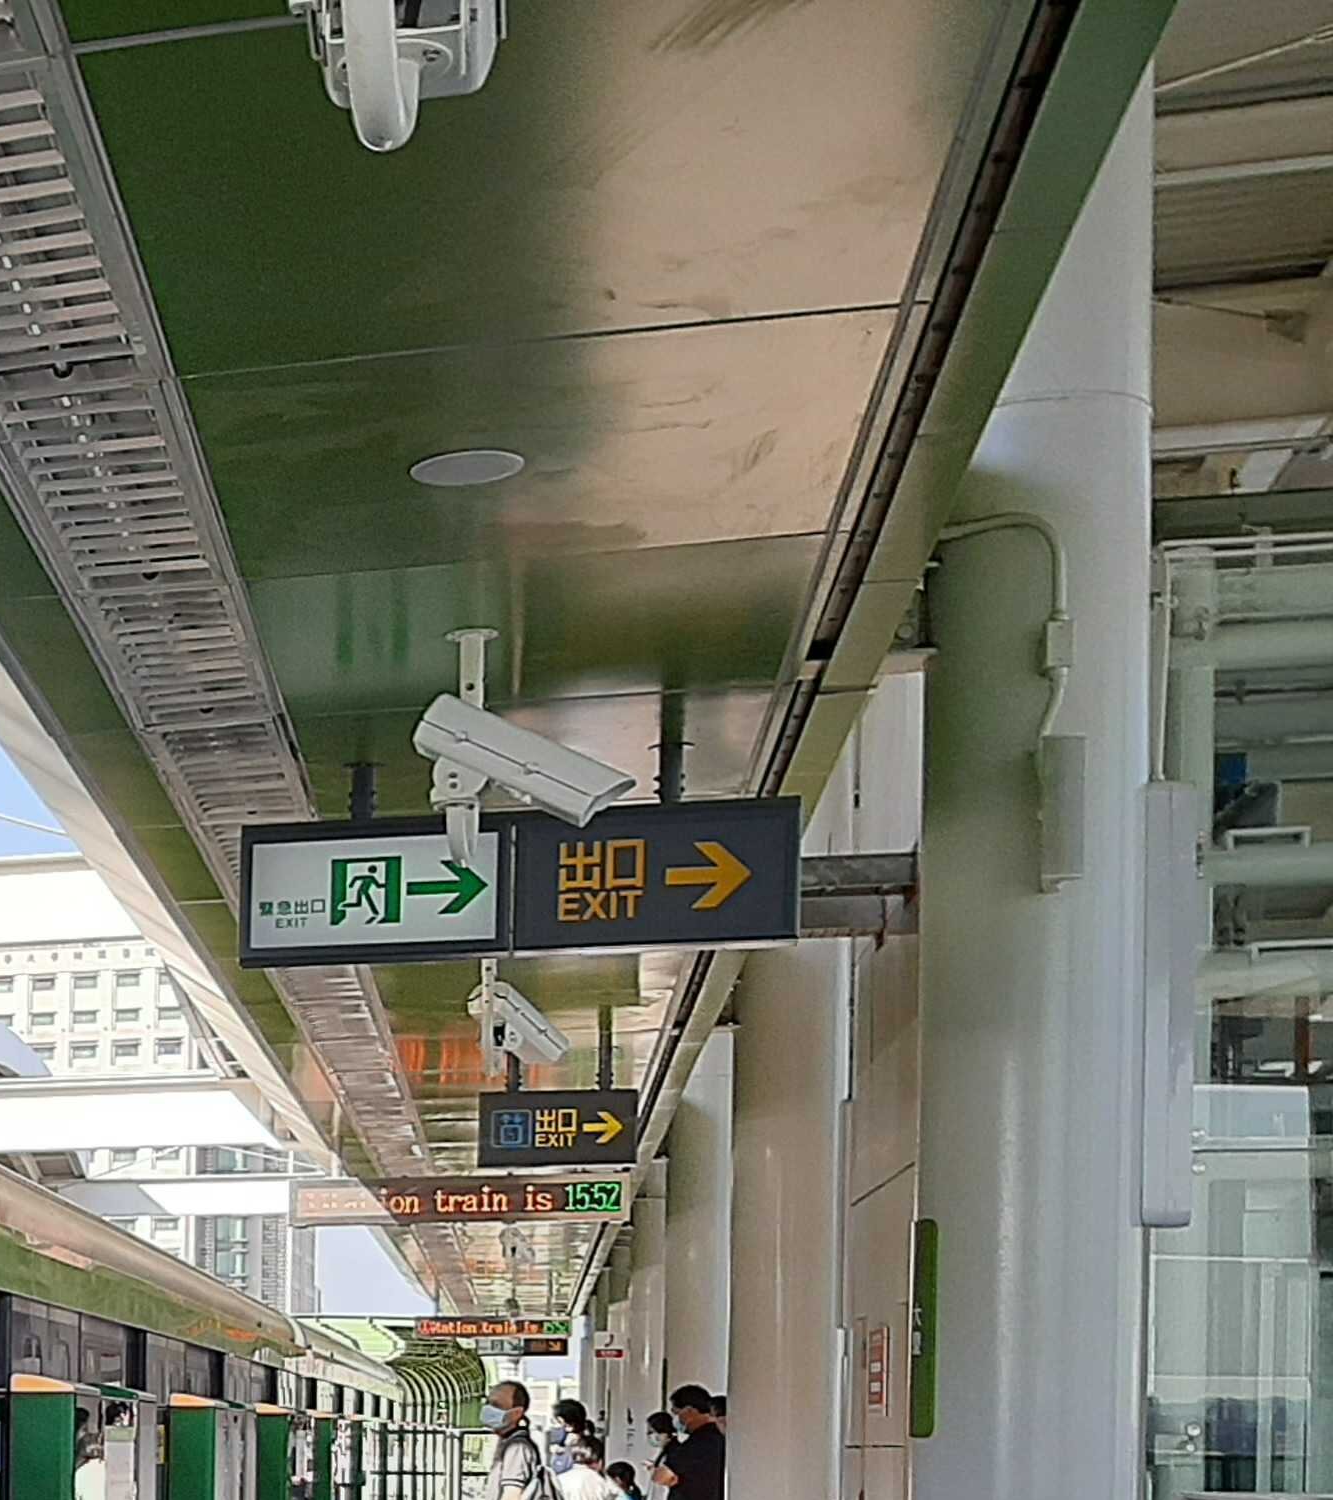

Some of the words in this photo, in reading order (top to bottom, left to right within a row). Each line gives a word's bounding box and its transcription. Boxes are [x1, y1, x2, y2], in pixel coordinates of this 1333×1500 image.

[558, 838, 646, 891] 出口
[557, 889, 643, 921] EXIT
[275, 917, 309, 929] EXIT
[535, 1107, 577, 1132] 出口
[535, 1132, 577, 1148] EXIT
[434, 1185, 508, 1213] train
[525, 1185, 553, 1210] is
